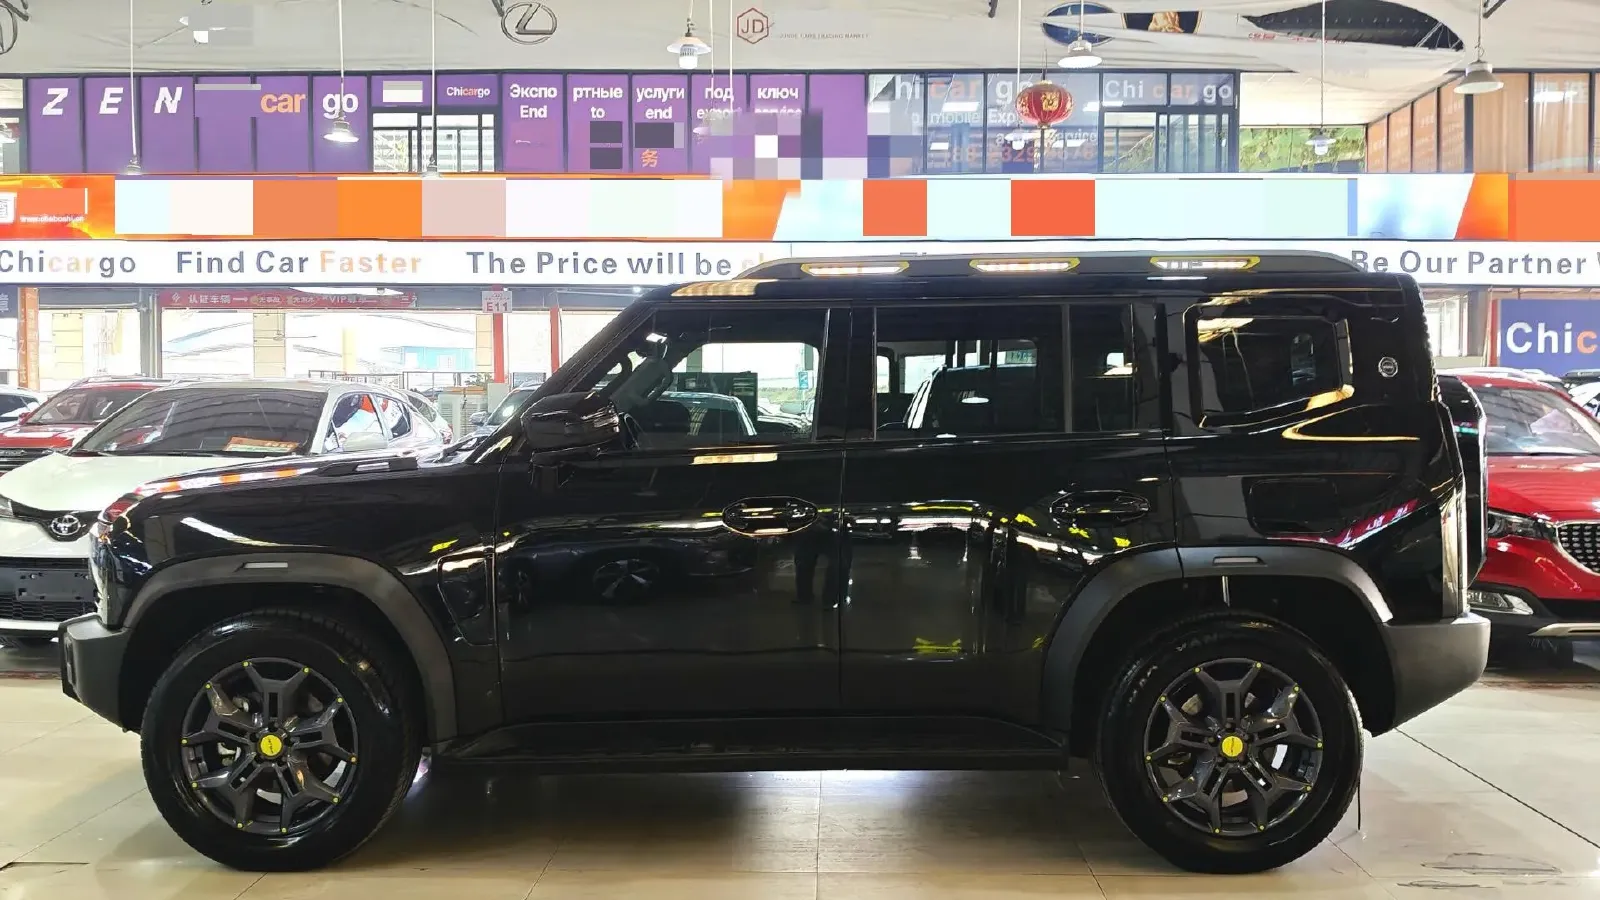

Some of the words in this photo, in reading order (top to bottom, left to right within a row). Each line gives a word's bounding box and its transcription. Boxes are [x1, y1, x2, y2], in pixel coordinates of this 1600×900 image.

[741, 19, 764, 33] JD
[446, 86, 490, 98] Chicargo
[510, 84, 558, 98] Экспо
[573, 86, 623, 101] ртные
[636, 86, 685, 102] услуги
[757, 87, 799, 99] ключ
[1203, 84, 1232, 104] go
[260, 92, 306, 113] car
[520, 105, 548, 119] End
[590, 106, 606, 119] to
[645, 106, 673, 120] end
[176, 250, 245, 274] Find
[256, 250, 309, 274] Car
[320, 250, 423, 274] Faster
[466, 251, 526, 274] The
[537, 251, 618, 274] Price
[627, 252, 684, 274] will
[695, 252, 732, 276] be
[1351, 250, 1389, 273] Be
[1399, 250, 1458, 273] Our
[1468, 251, 1587, 274] Partner
[486, 302, 508, 311] E11
